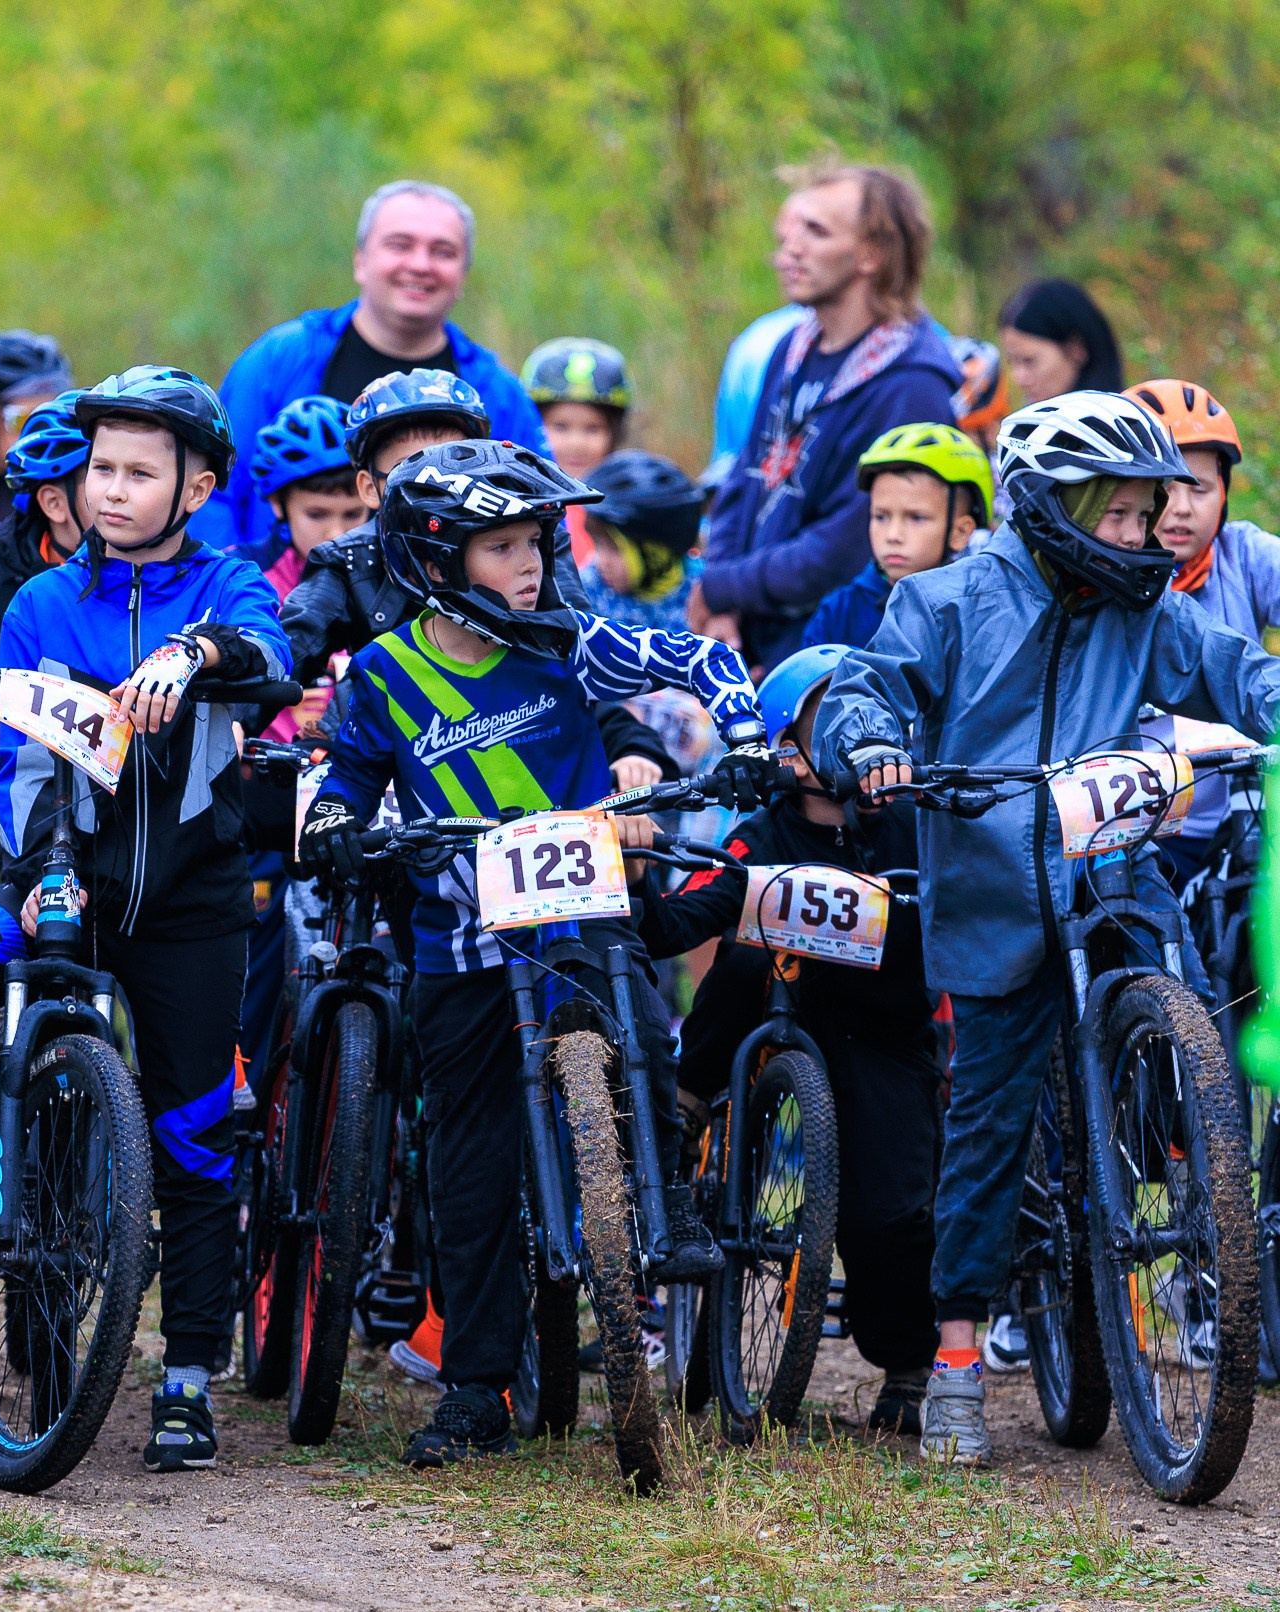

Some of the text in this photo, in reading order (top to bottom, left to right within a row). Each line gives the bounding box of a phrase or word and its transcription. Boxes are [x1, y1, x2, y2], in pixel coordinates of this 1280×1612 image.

[414, 465, 534, 517] MET
[29, 683, 105, 751] 144
[1081, 769, 1168, 823] 125
[305, 815, 354, 835] FOX
[505, 840, 596, 894] 123
[778, 877, 859, 932] 153
